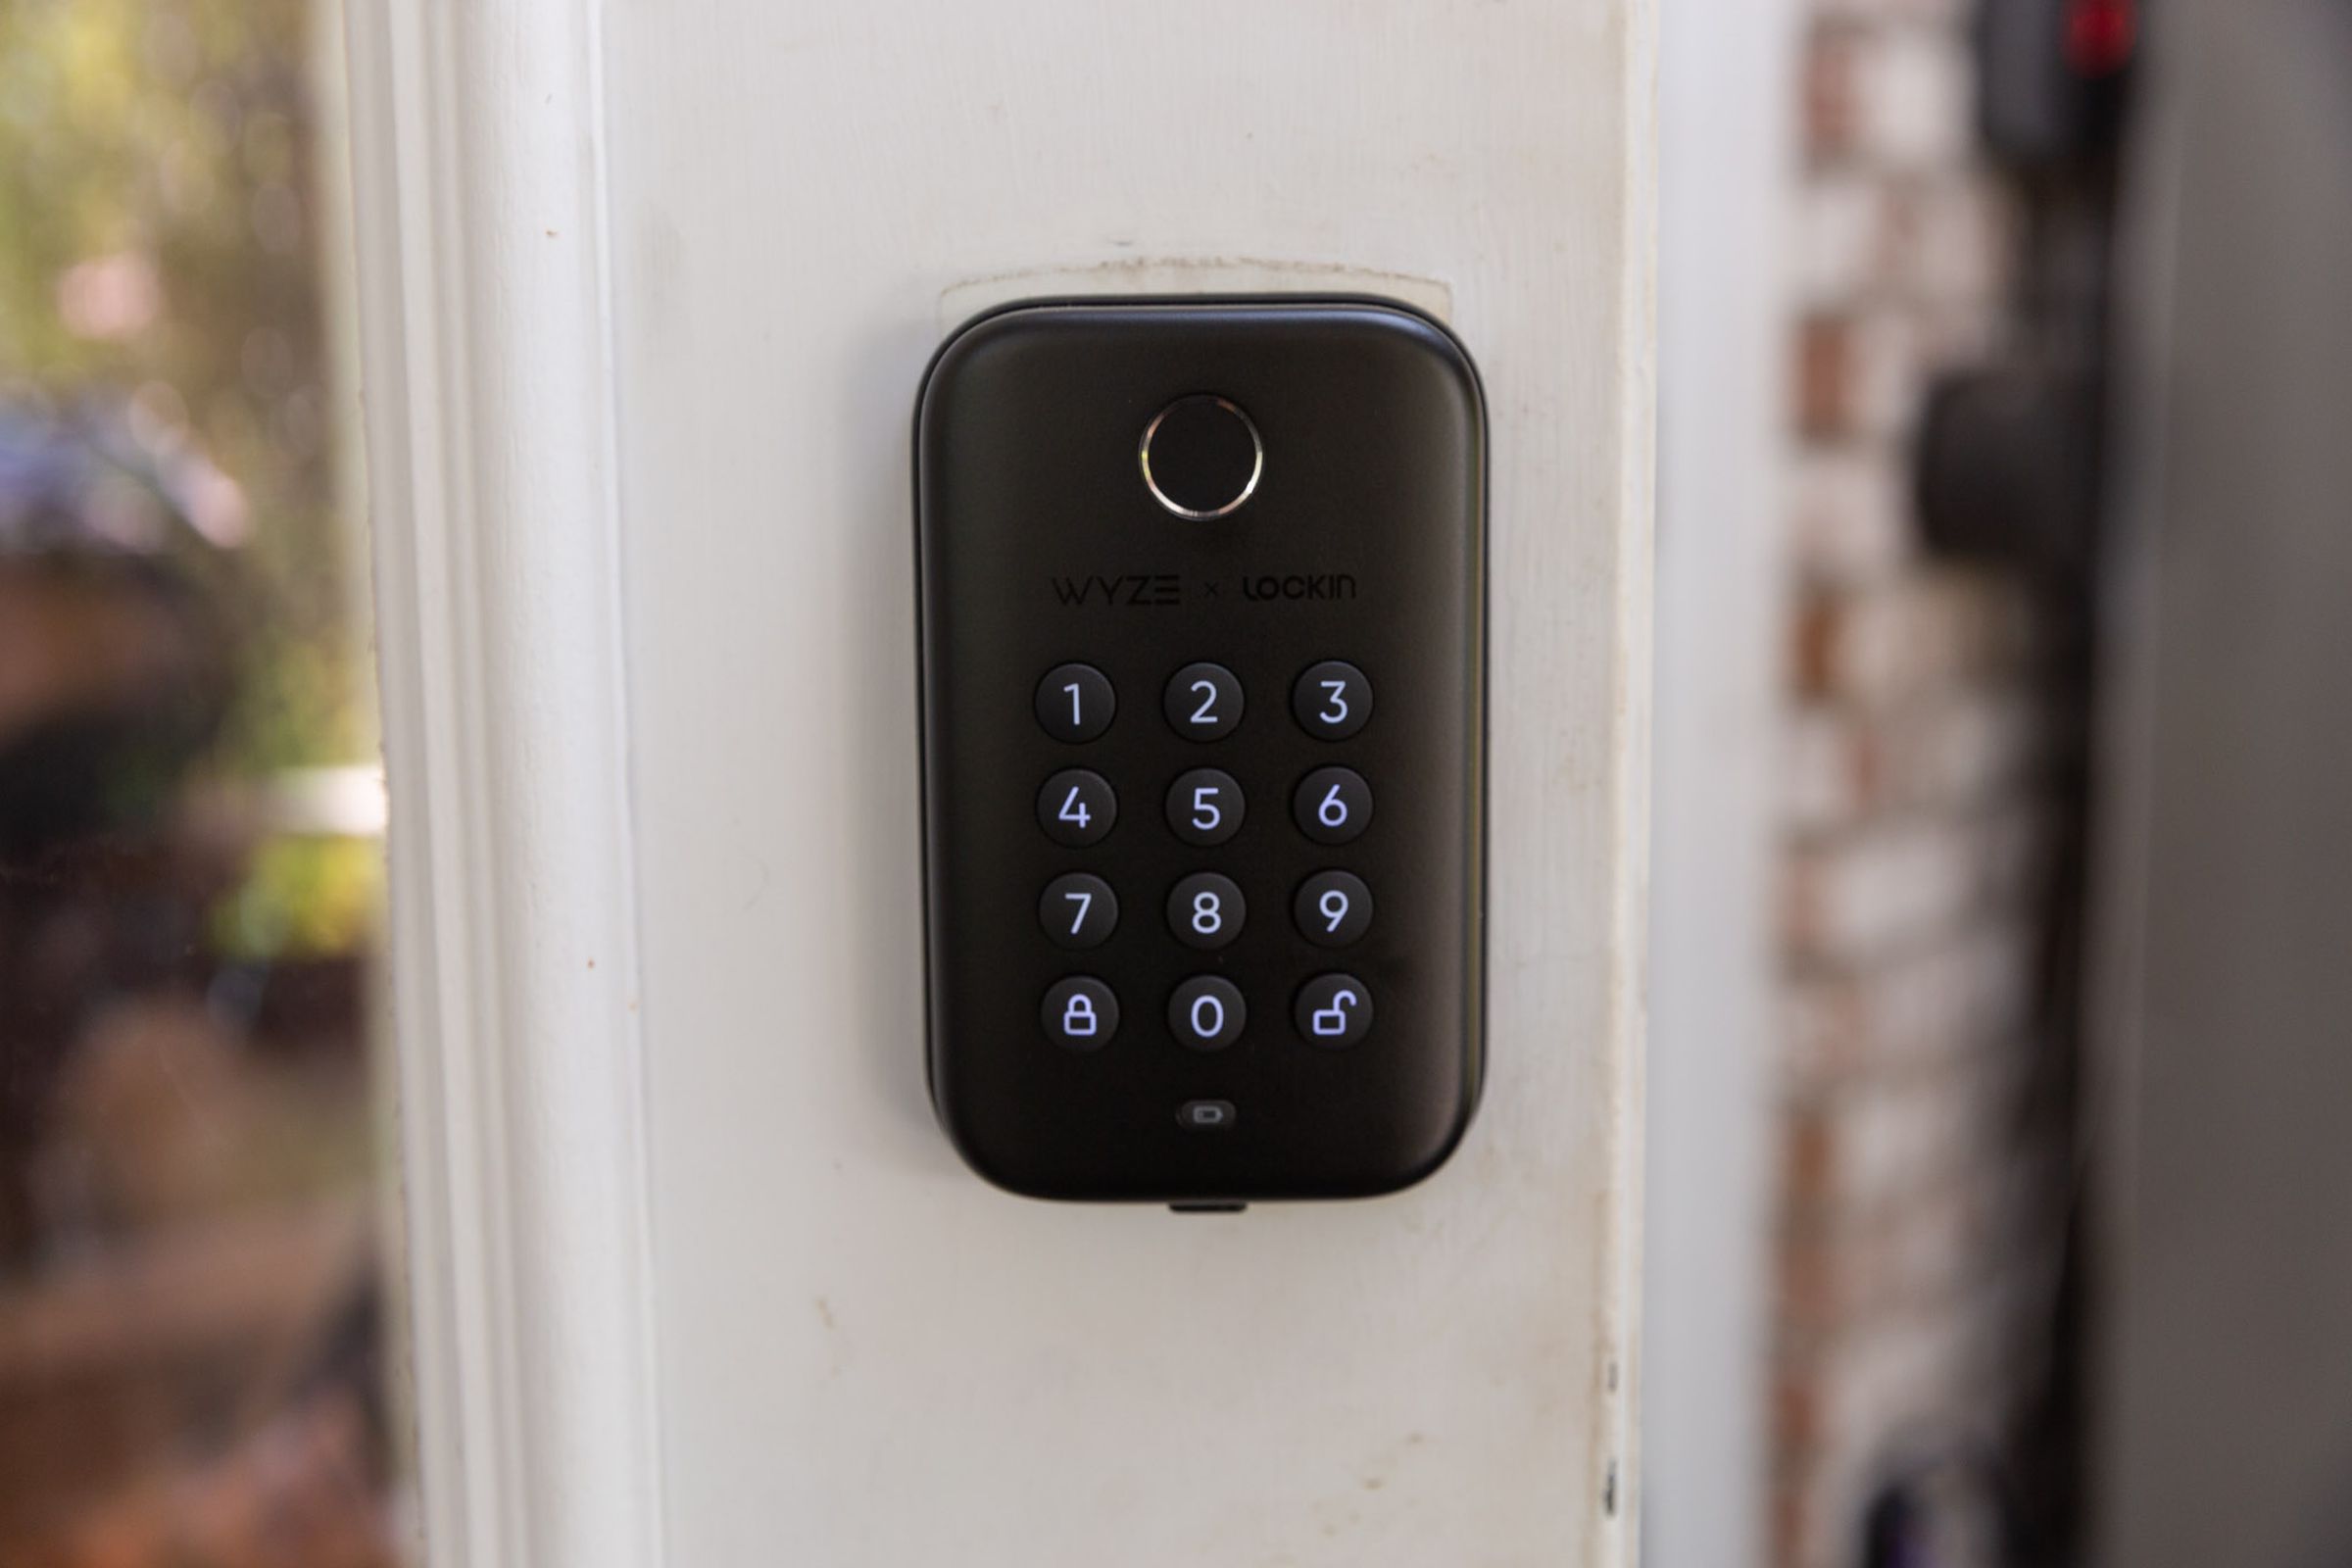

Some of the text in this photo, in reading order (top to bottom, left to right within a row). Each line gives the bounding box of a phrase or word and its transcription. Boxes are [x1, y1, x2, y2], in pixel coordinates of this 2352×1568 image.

[1052, 575, 1181, 606] WYZE
[1062, 680, 1348, 725] 1 2 3
[1058, 784, 1348, 830] 4 5 6
[1065, 890, 1348, 934] 7 8 9
[1191, 995, 1224, 1037] 0
